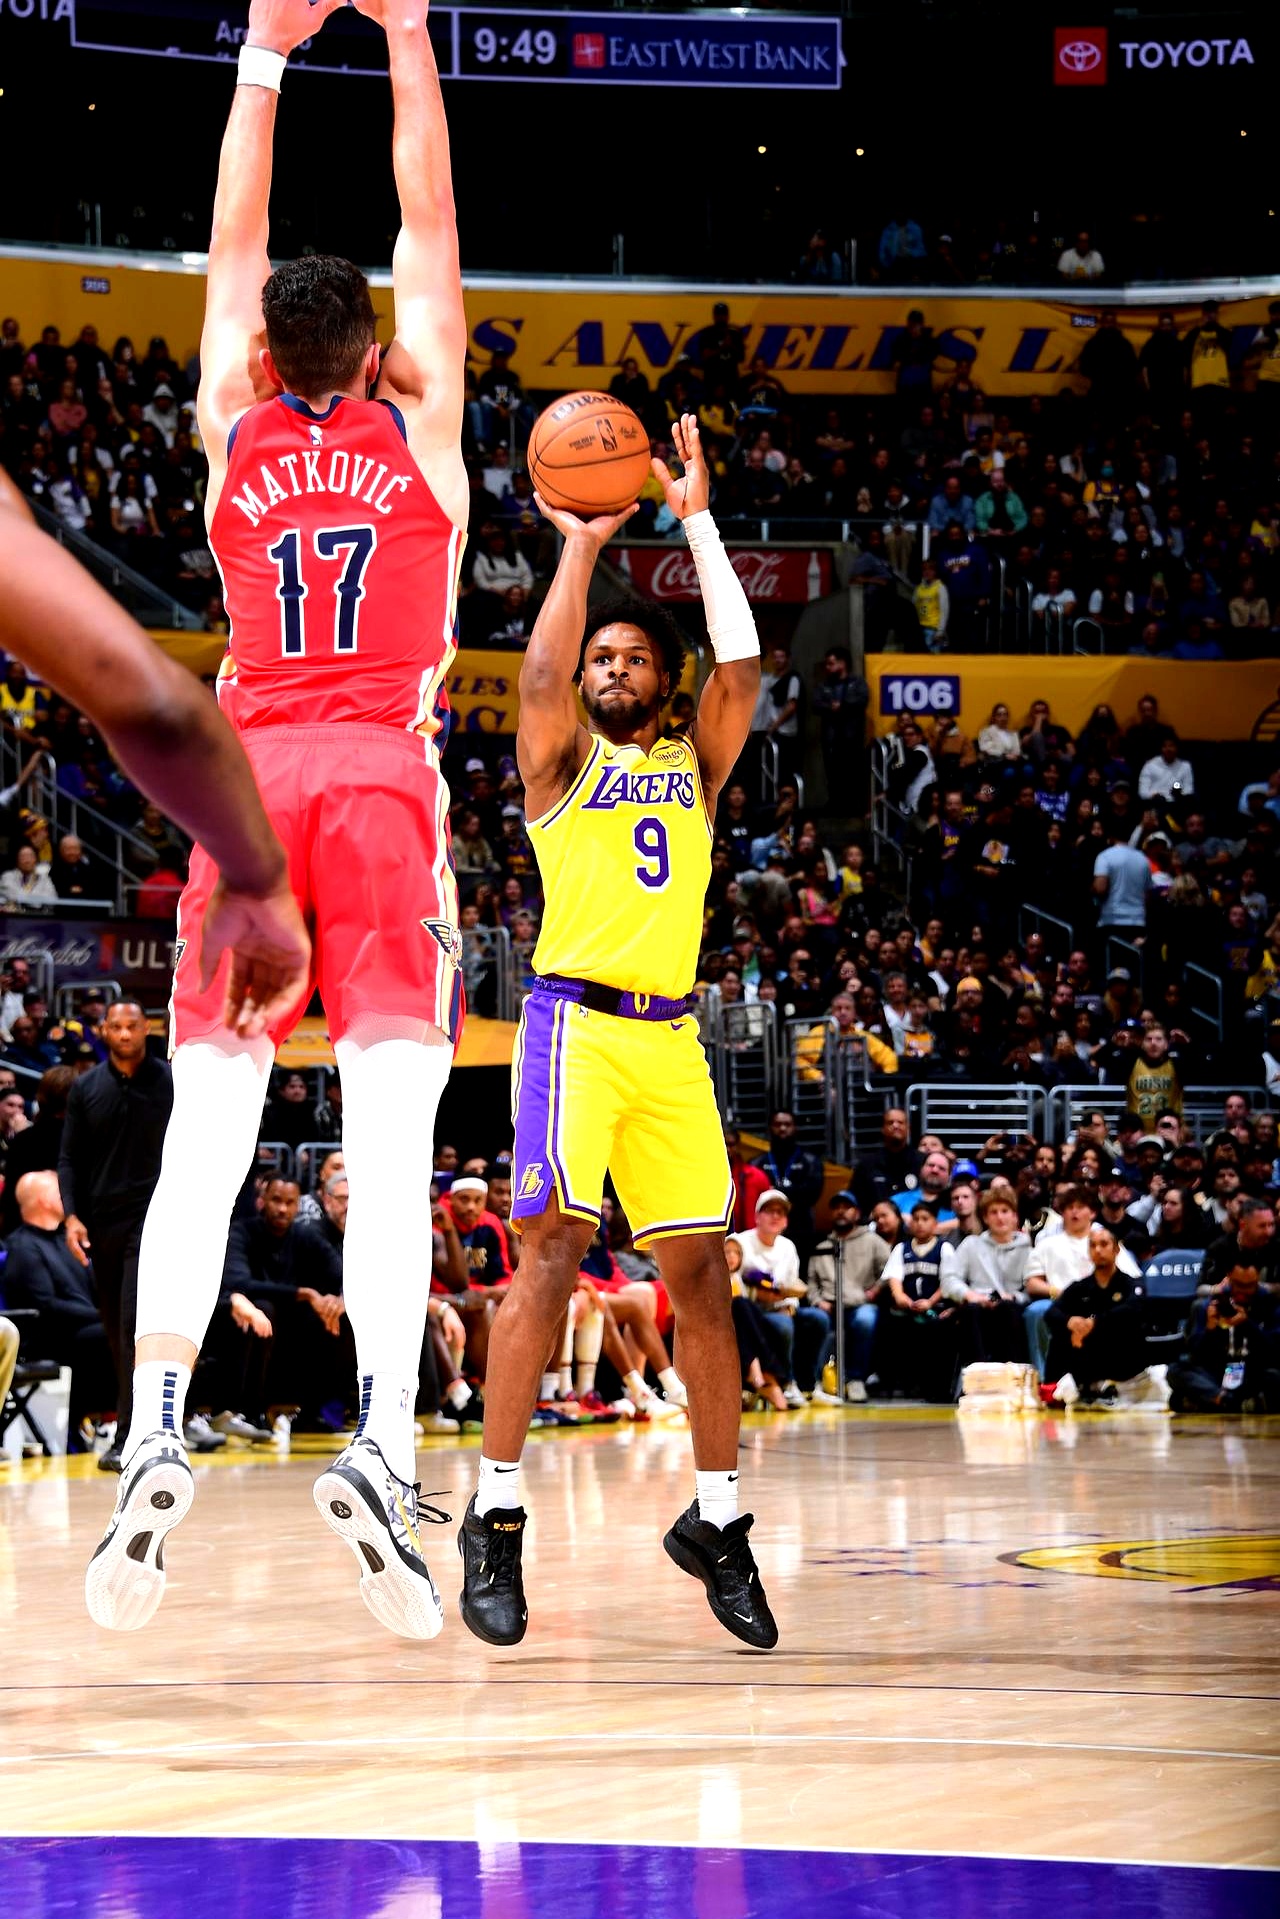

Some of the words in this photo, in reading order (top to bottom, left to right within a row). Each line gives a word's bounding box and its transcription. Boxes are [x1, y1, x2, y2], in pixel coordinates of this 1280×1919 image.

[0, 0, 74, 21] OTA
[474, 27, 557, 65] 9:49
[1119, 38, 1255, 69] TOYOTA
[231, 450, 413, 527] MATKOVIĆ
[267, 523, 377, 657] 17
[887, 680, 954, 710] 106
[580, 765, 696, 810] LAKERS
[632, 816, 672, 890] 9
